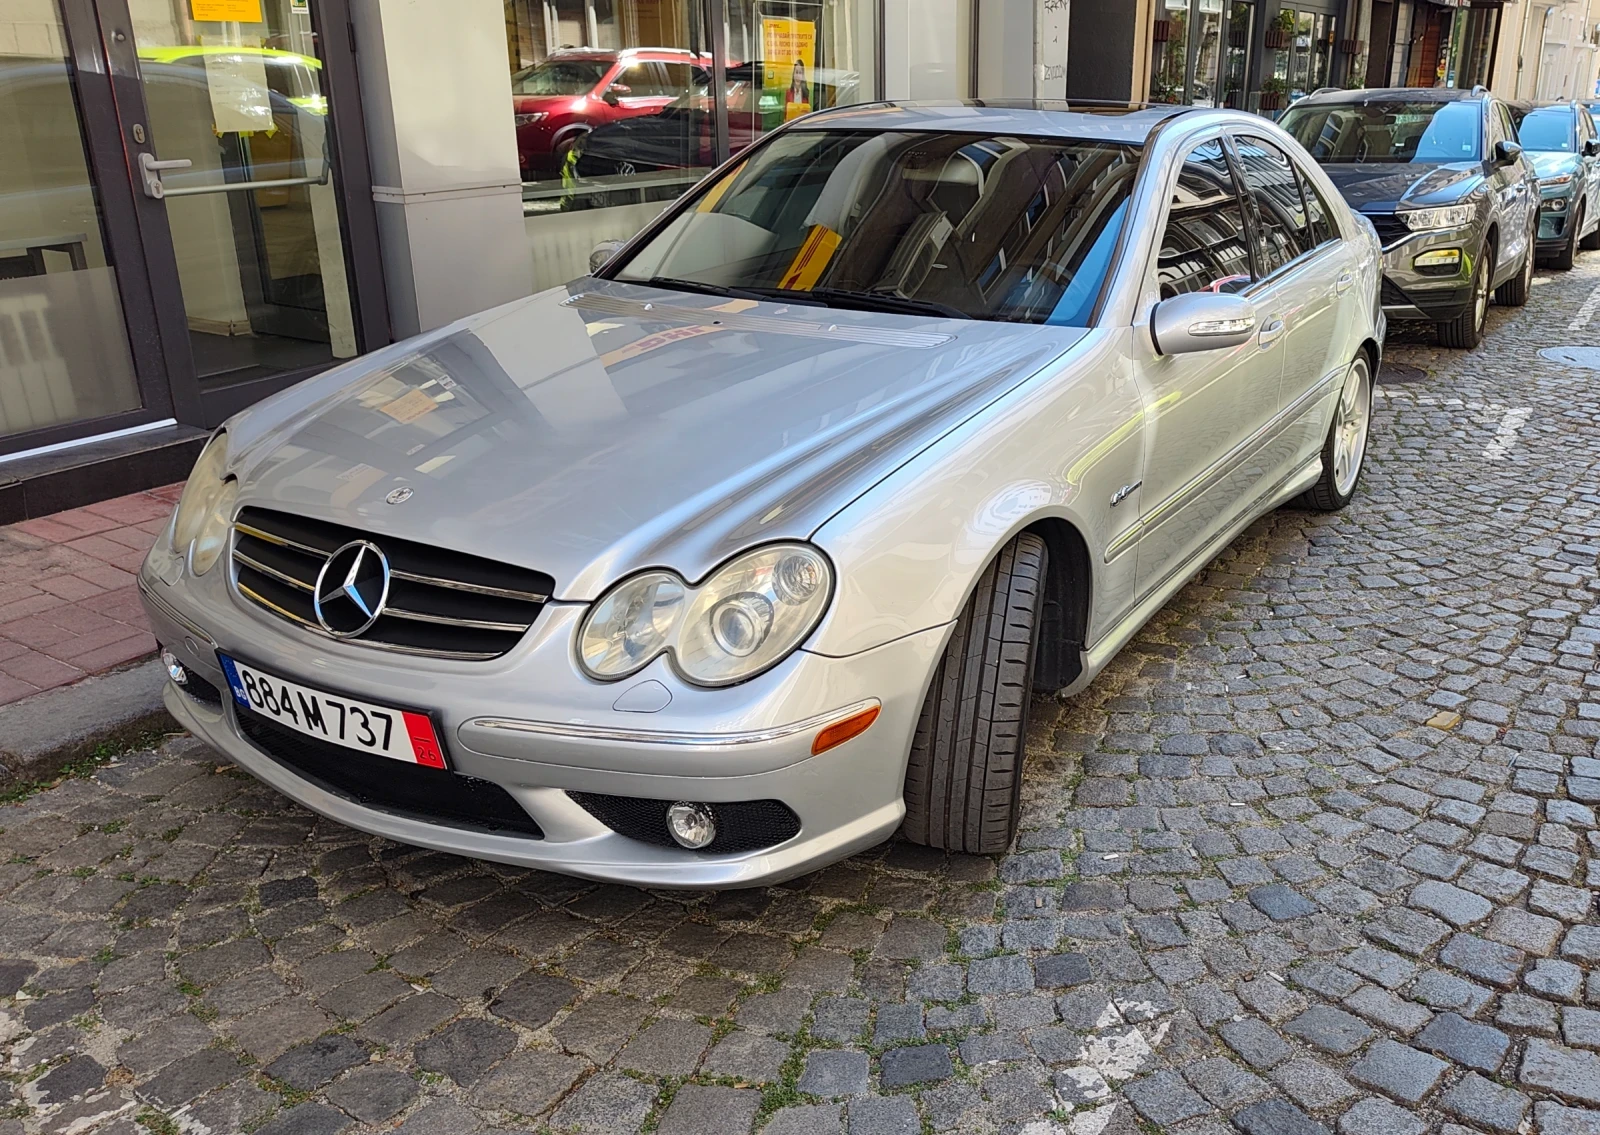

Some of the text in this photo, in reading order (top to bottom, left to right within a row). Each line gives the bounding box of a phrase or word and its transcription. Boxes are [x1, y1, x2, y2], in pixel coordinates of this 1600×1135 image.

[233, 685, 247, 700] BG
[242, 670, 393, 751] 884M737
[417, 746, 437, 761] 26
